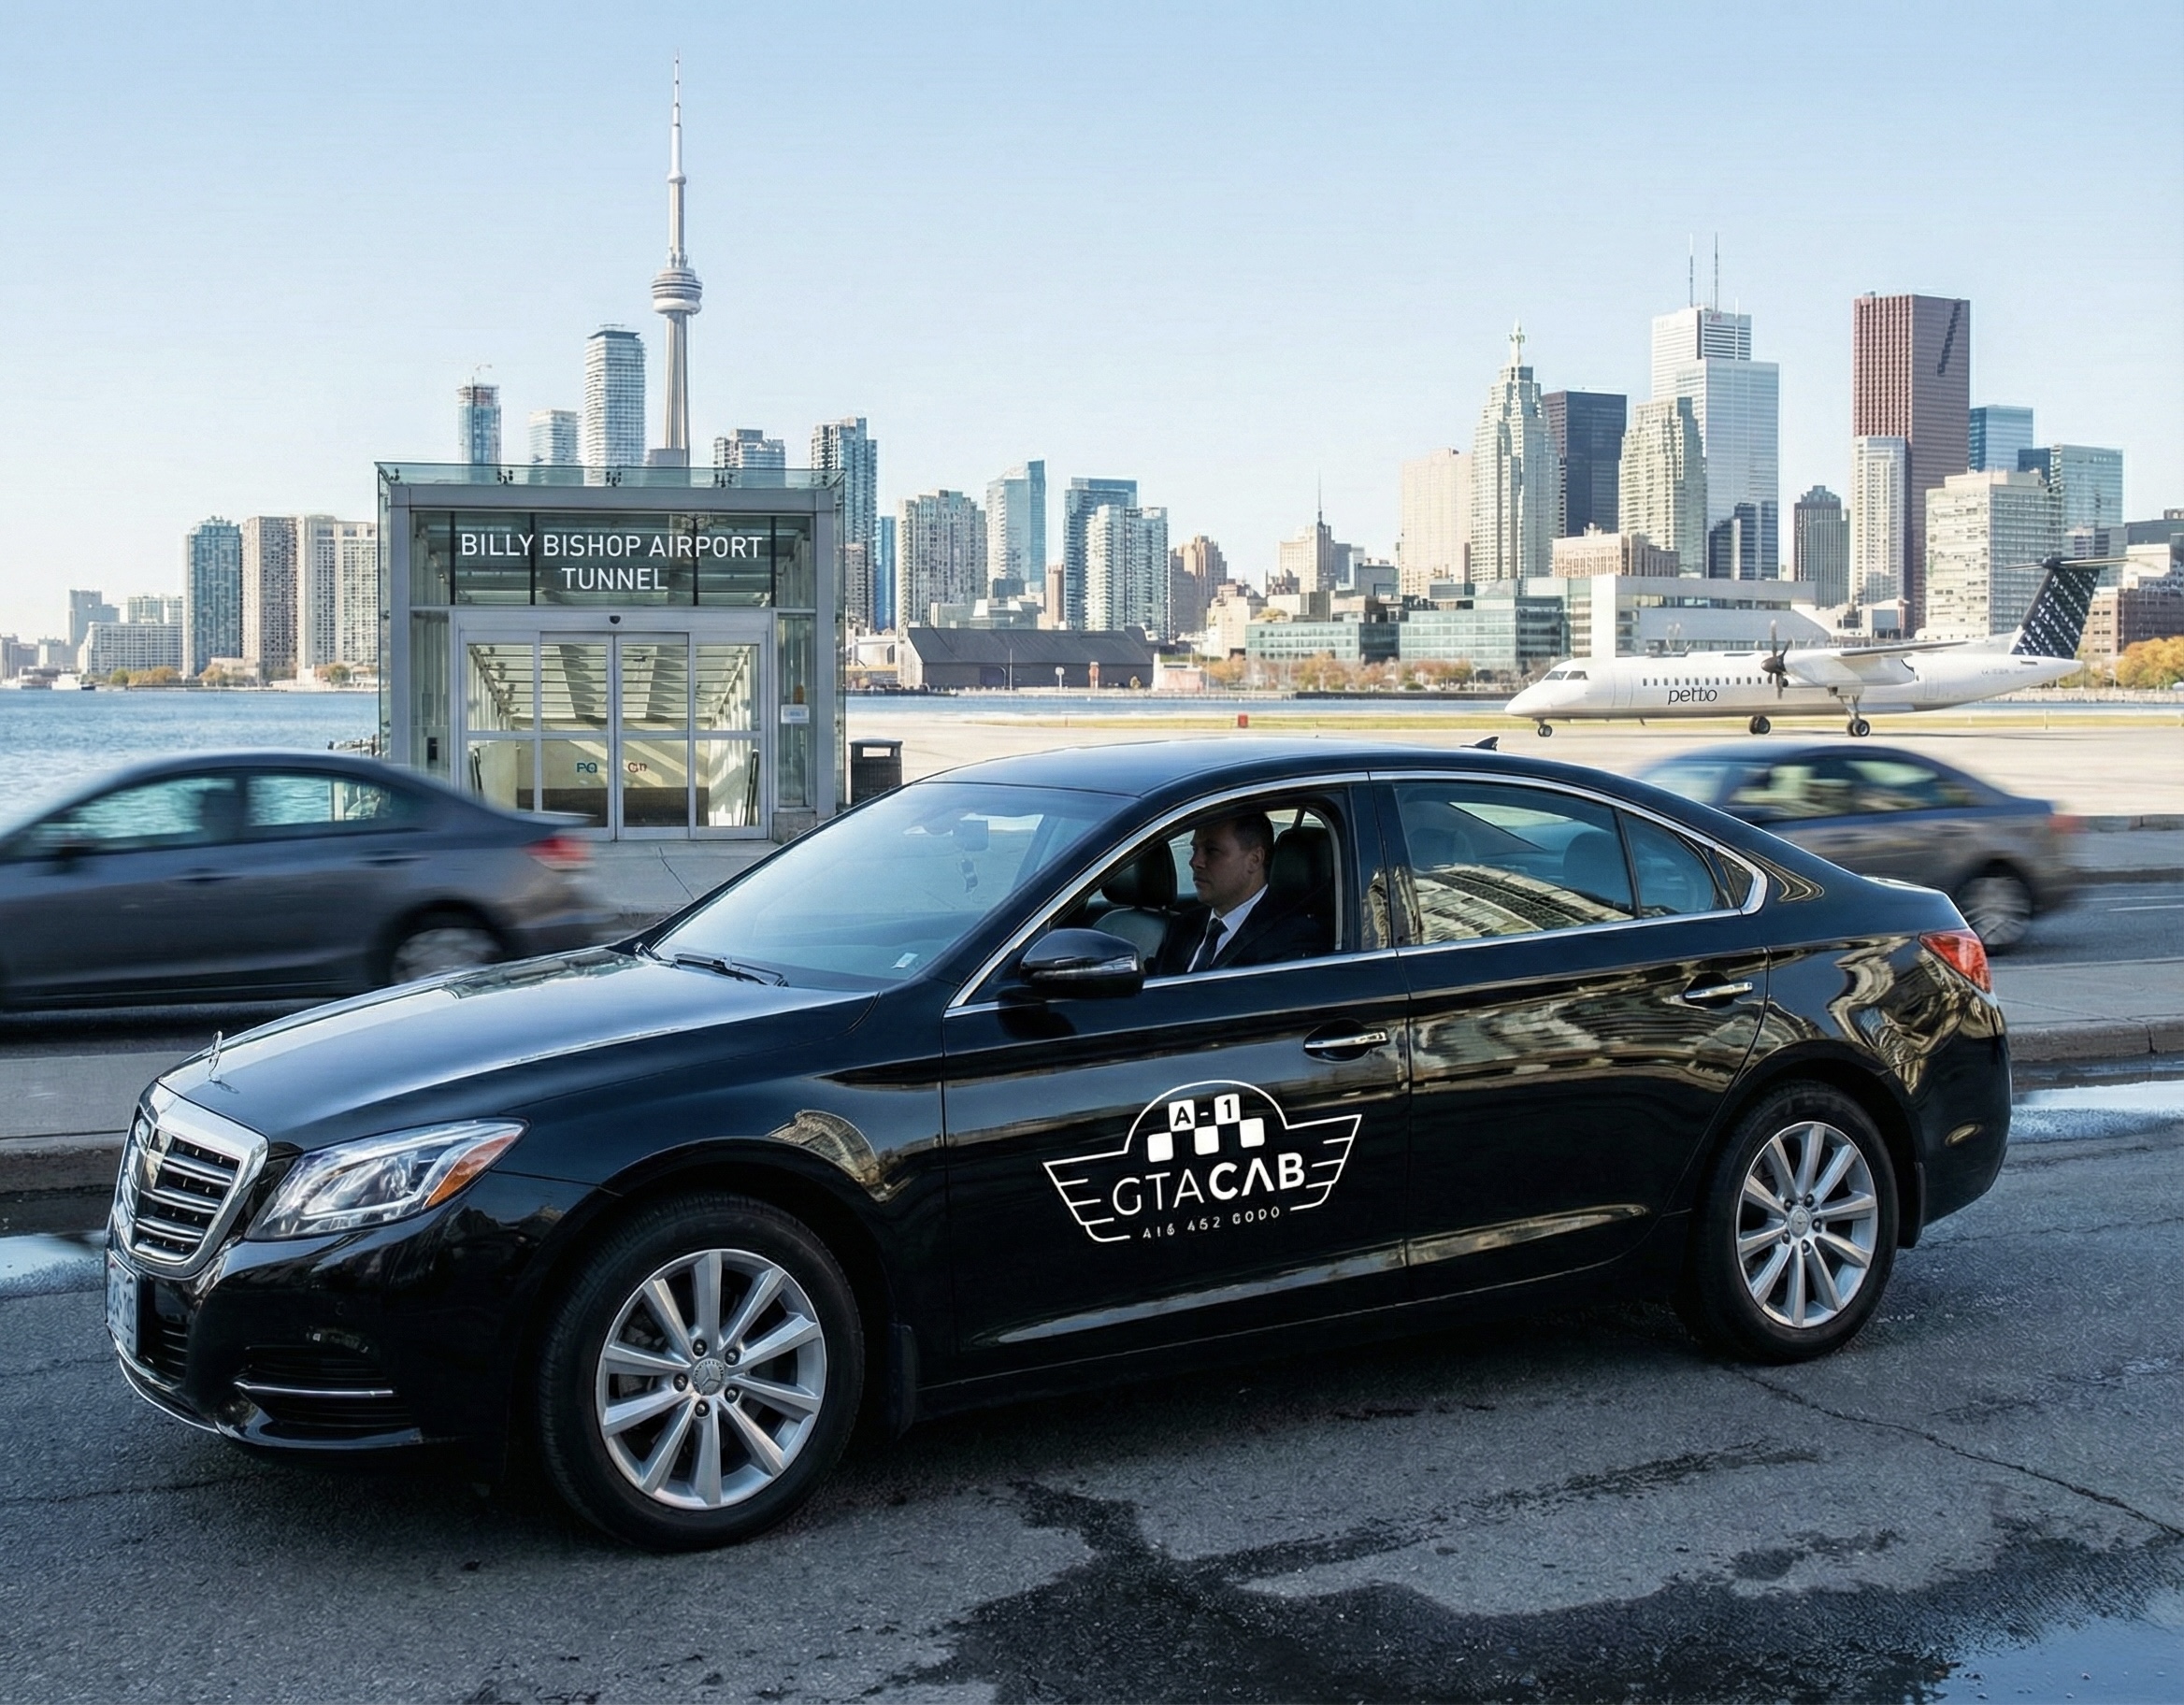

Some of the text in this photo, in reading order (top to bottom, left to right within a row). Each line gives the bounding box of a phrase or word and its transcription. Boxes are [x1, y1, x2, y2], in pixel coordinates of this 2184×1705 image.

[461, 534, 763, 558] BILLY BISHOP AIRPORT
[561, 567, 668, 590] TUNNEL
[1174, 1097, 1233, 1126] A-1
